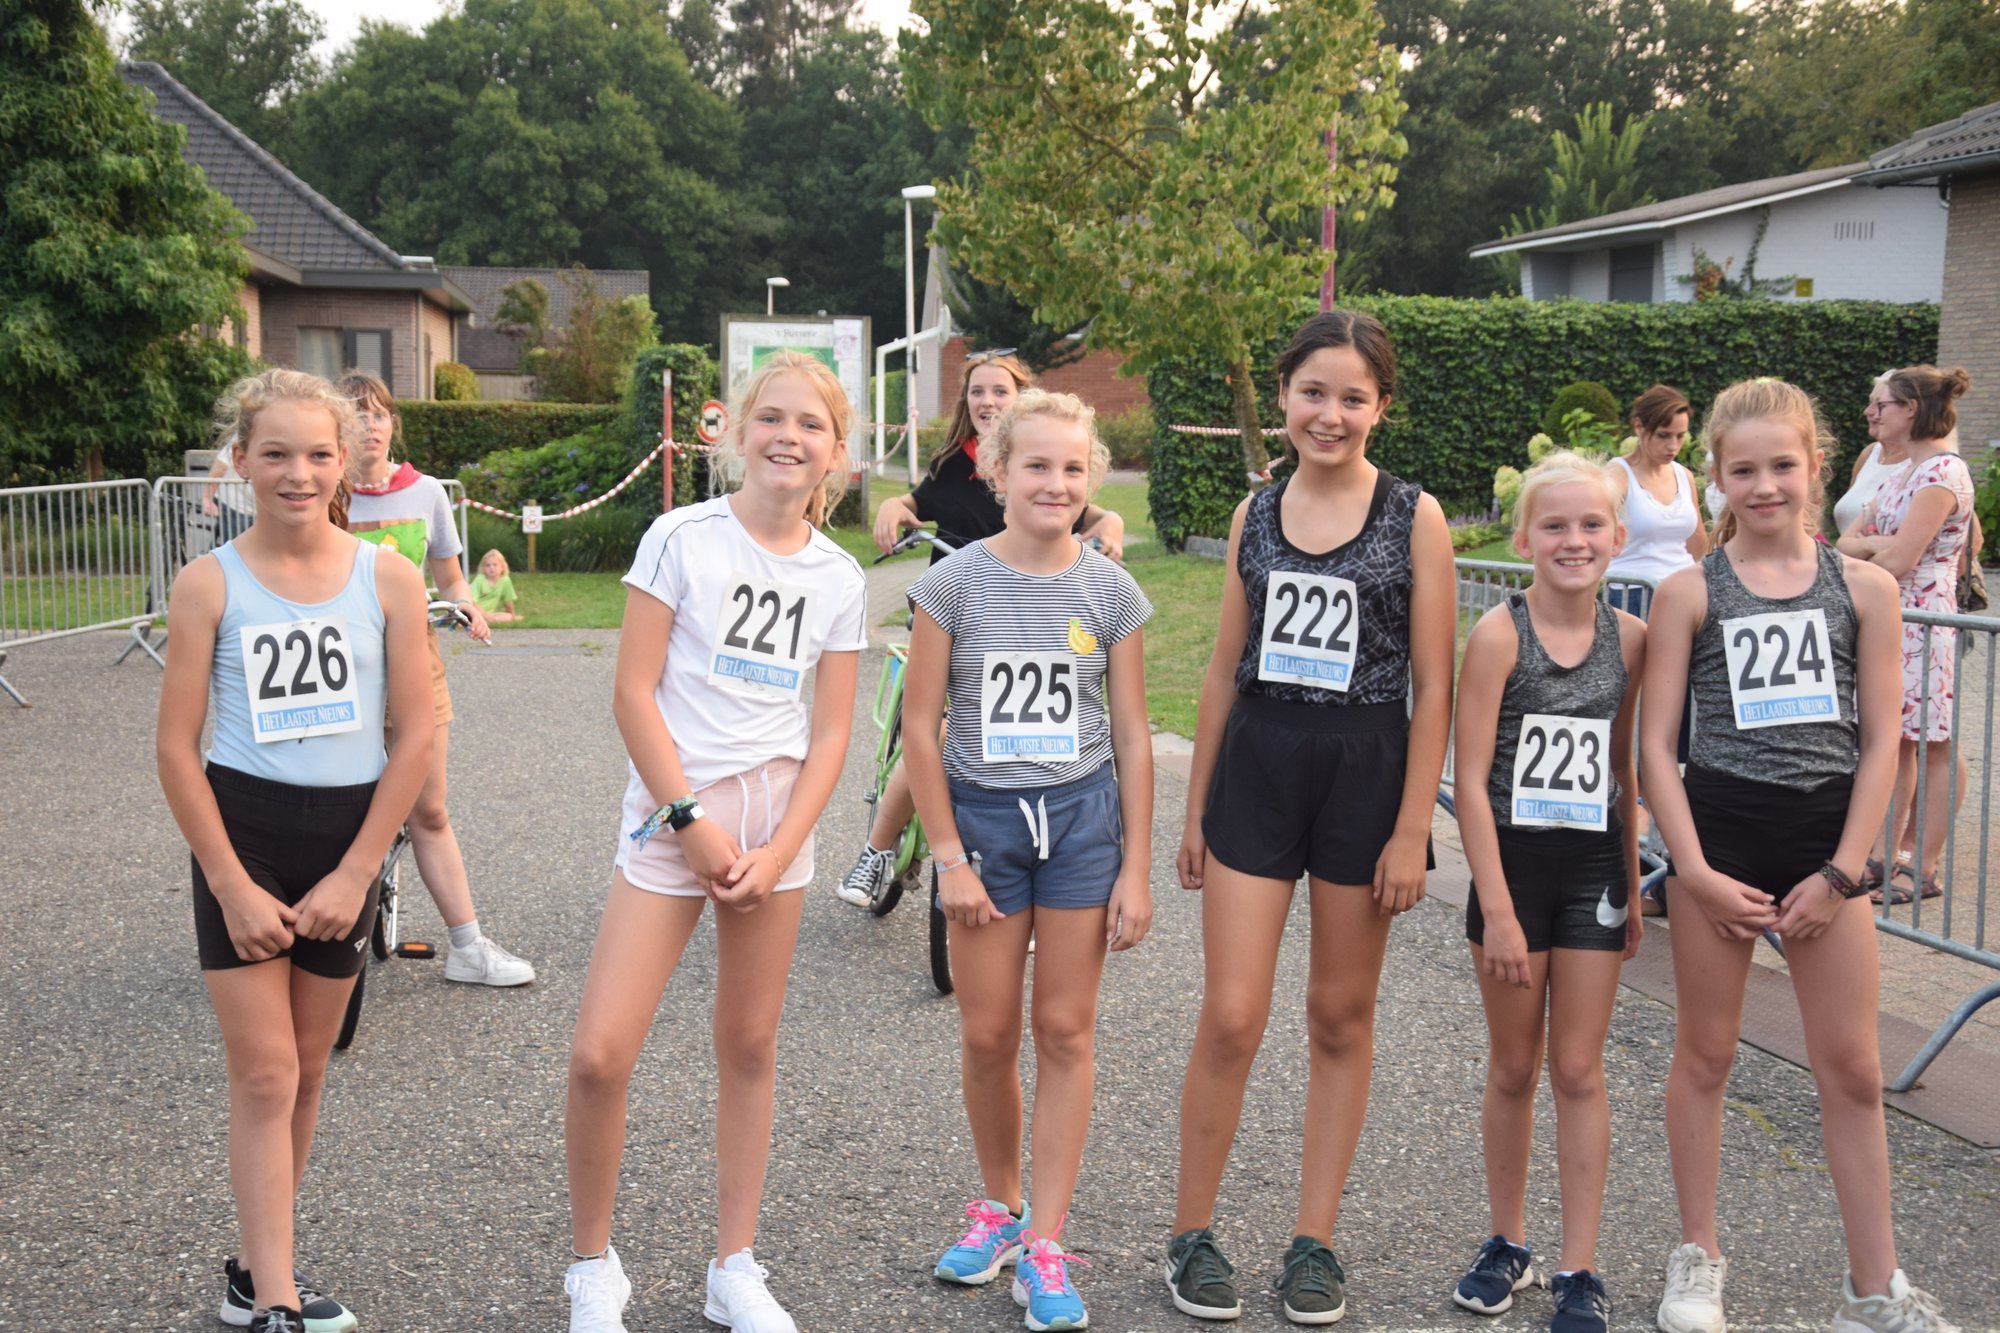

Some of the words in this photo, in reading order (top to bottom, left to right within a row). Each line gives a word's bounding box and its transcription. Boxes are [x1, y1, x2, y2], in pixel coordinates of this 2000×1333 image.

[724, 584, 806, 660] 221
[1270, 582, 1353, 653] 222
[253, 626, 348, 700] 226
[1733, 620, 1825, 691] 224
[989, 661, 1072, 724] 225
[1520, 726, 1601, 793] 223
